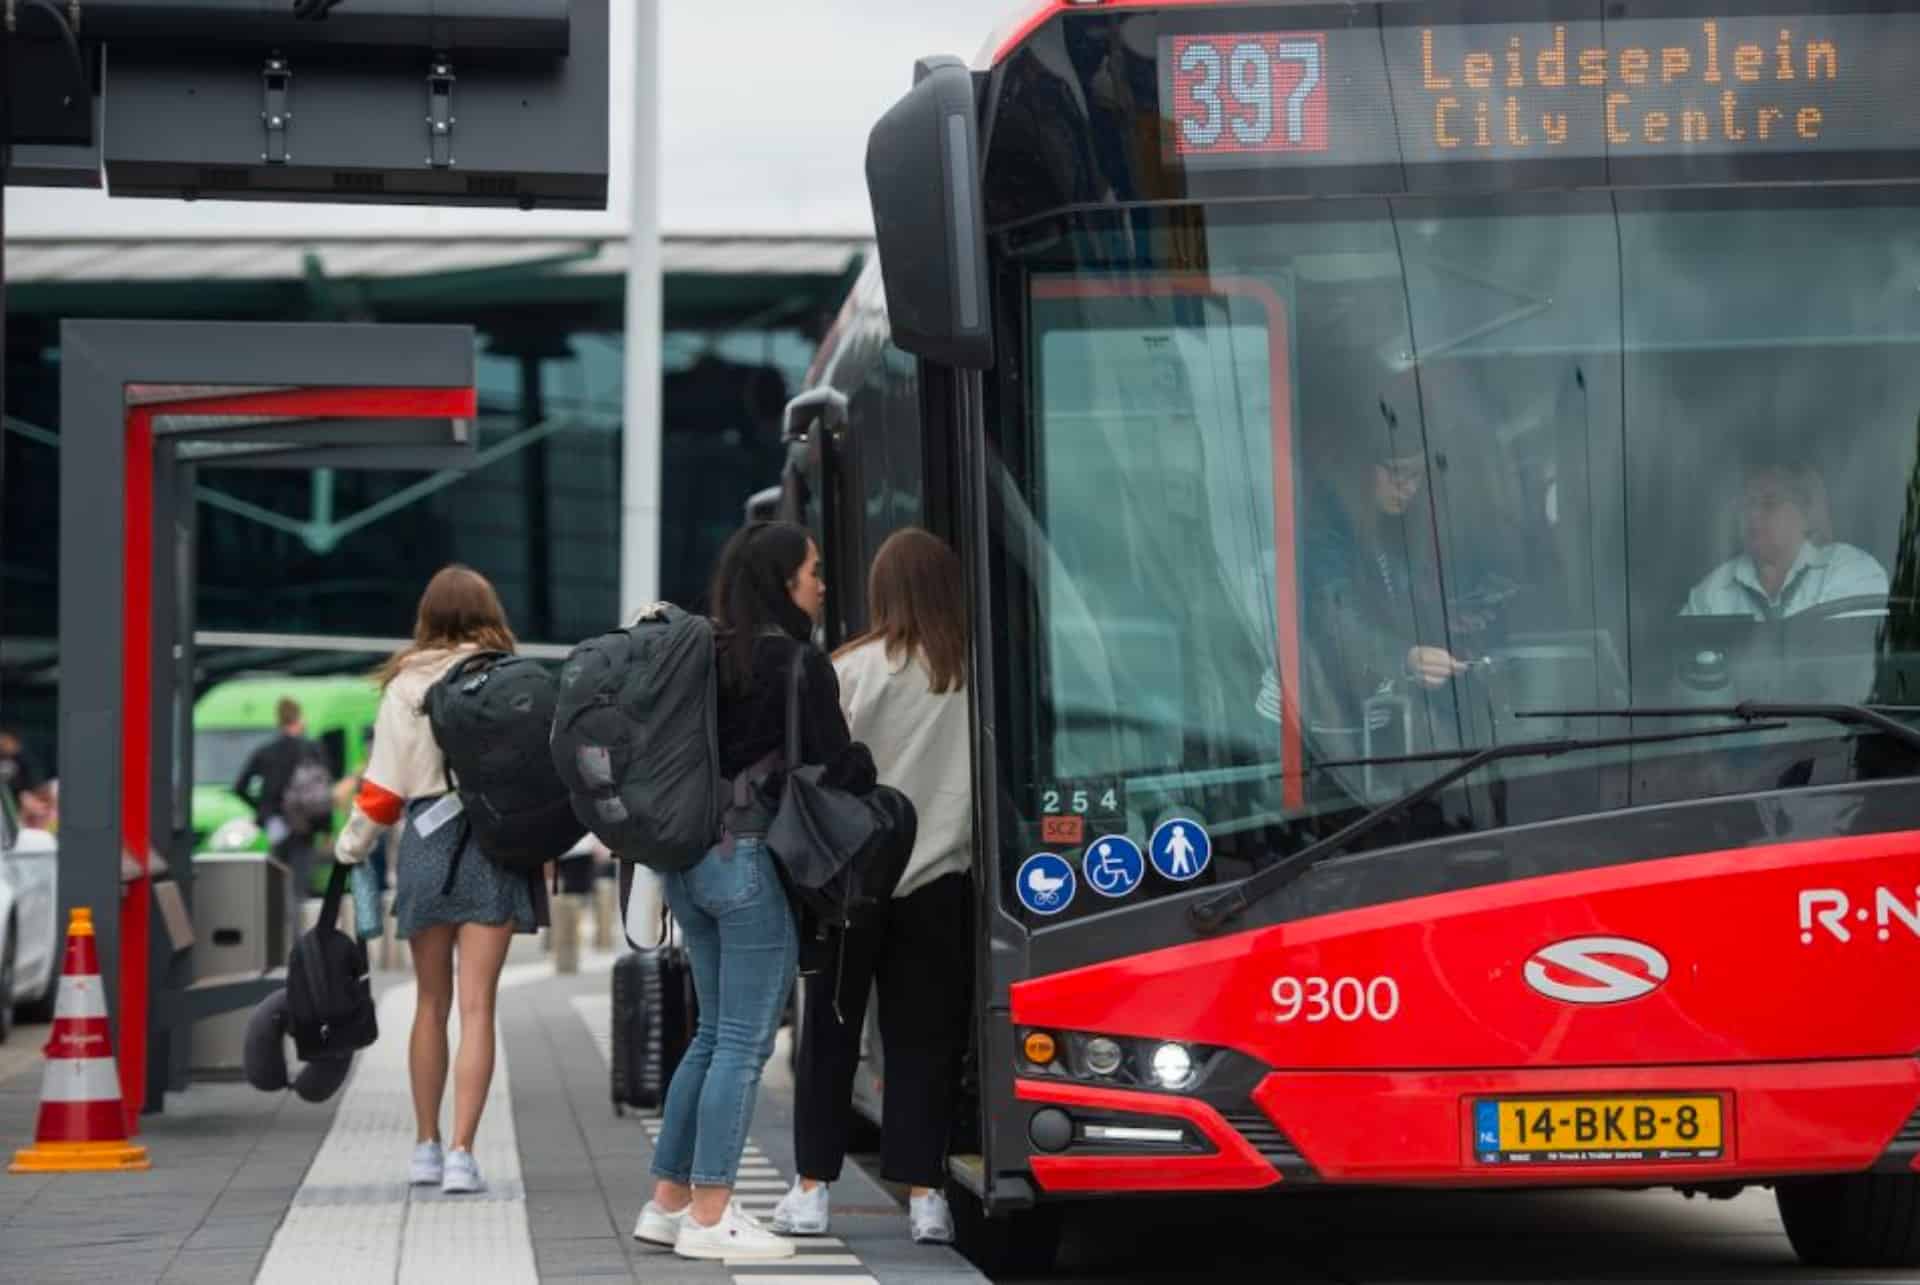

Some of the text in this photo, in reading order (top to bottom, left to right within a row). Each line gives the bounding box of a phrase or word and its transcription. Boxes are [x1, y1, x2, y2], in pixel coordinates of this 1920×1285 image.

[1420, 17, 1838, 89] Leidseplein
[1180, 42, 1321, 144] 397
[1434, 89, 1824, 147] City Centre
[1271, 976, 1399, 1022] 9300
[1480, 1131, 1497, 1144] NL
[1514, 1105, 1700, 1144] 14-BKB-8
